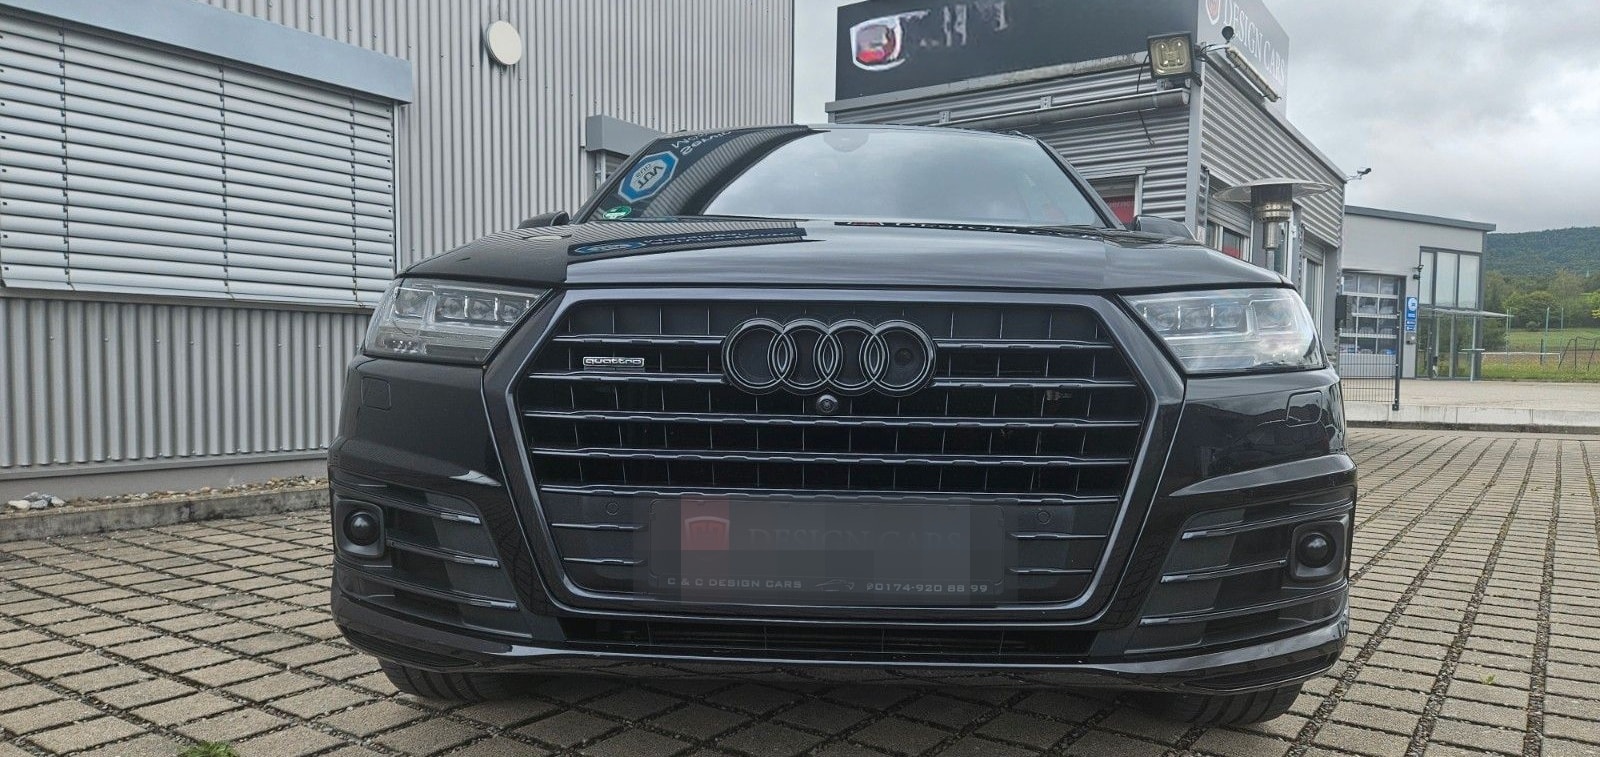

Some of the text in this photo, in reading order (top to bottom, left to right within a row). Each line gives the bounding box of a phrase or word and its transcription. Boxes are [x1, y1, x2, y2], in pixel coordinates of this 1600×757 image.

[1263, 40, 1285, 86] CARS
[586, 357, 642, 365] quattro
[667, 577, 676, 585] C
[680, 577, 690, 586] &
[694, 578, 703, 587] C
[708, 578, 760, 588] DESIGN
[765, 579, 802, 589] CARS
[970, 584, 988, 593] 99
